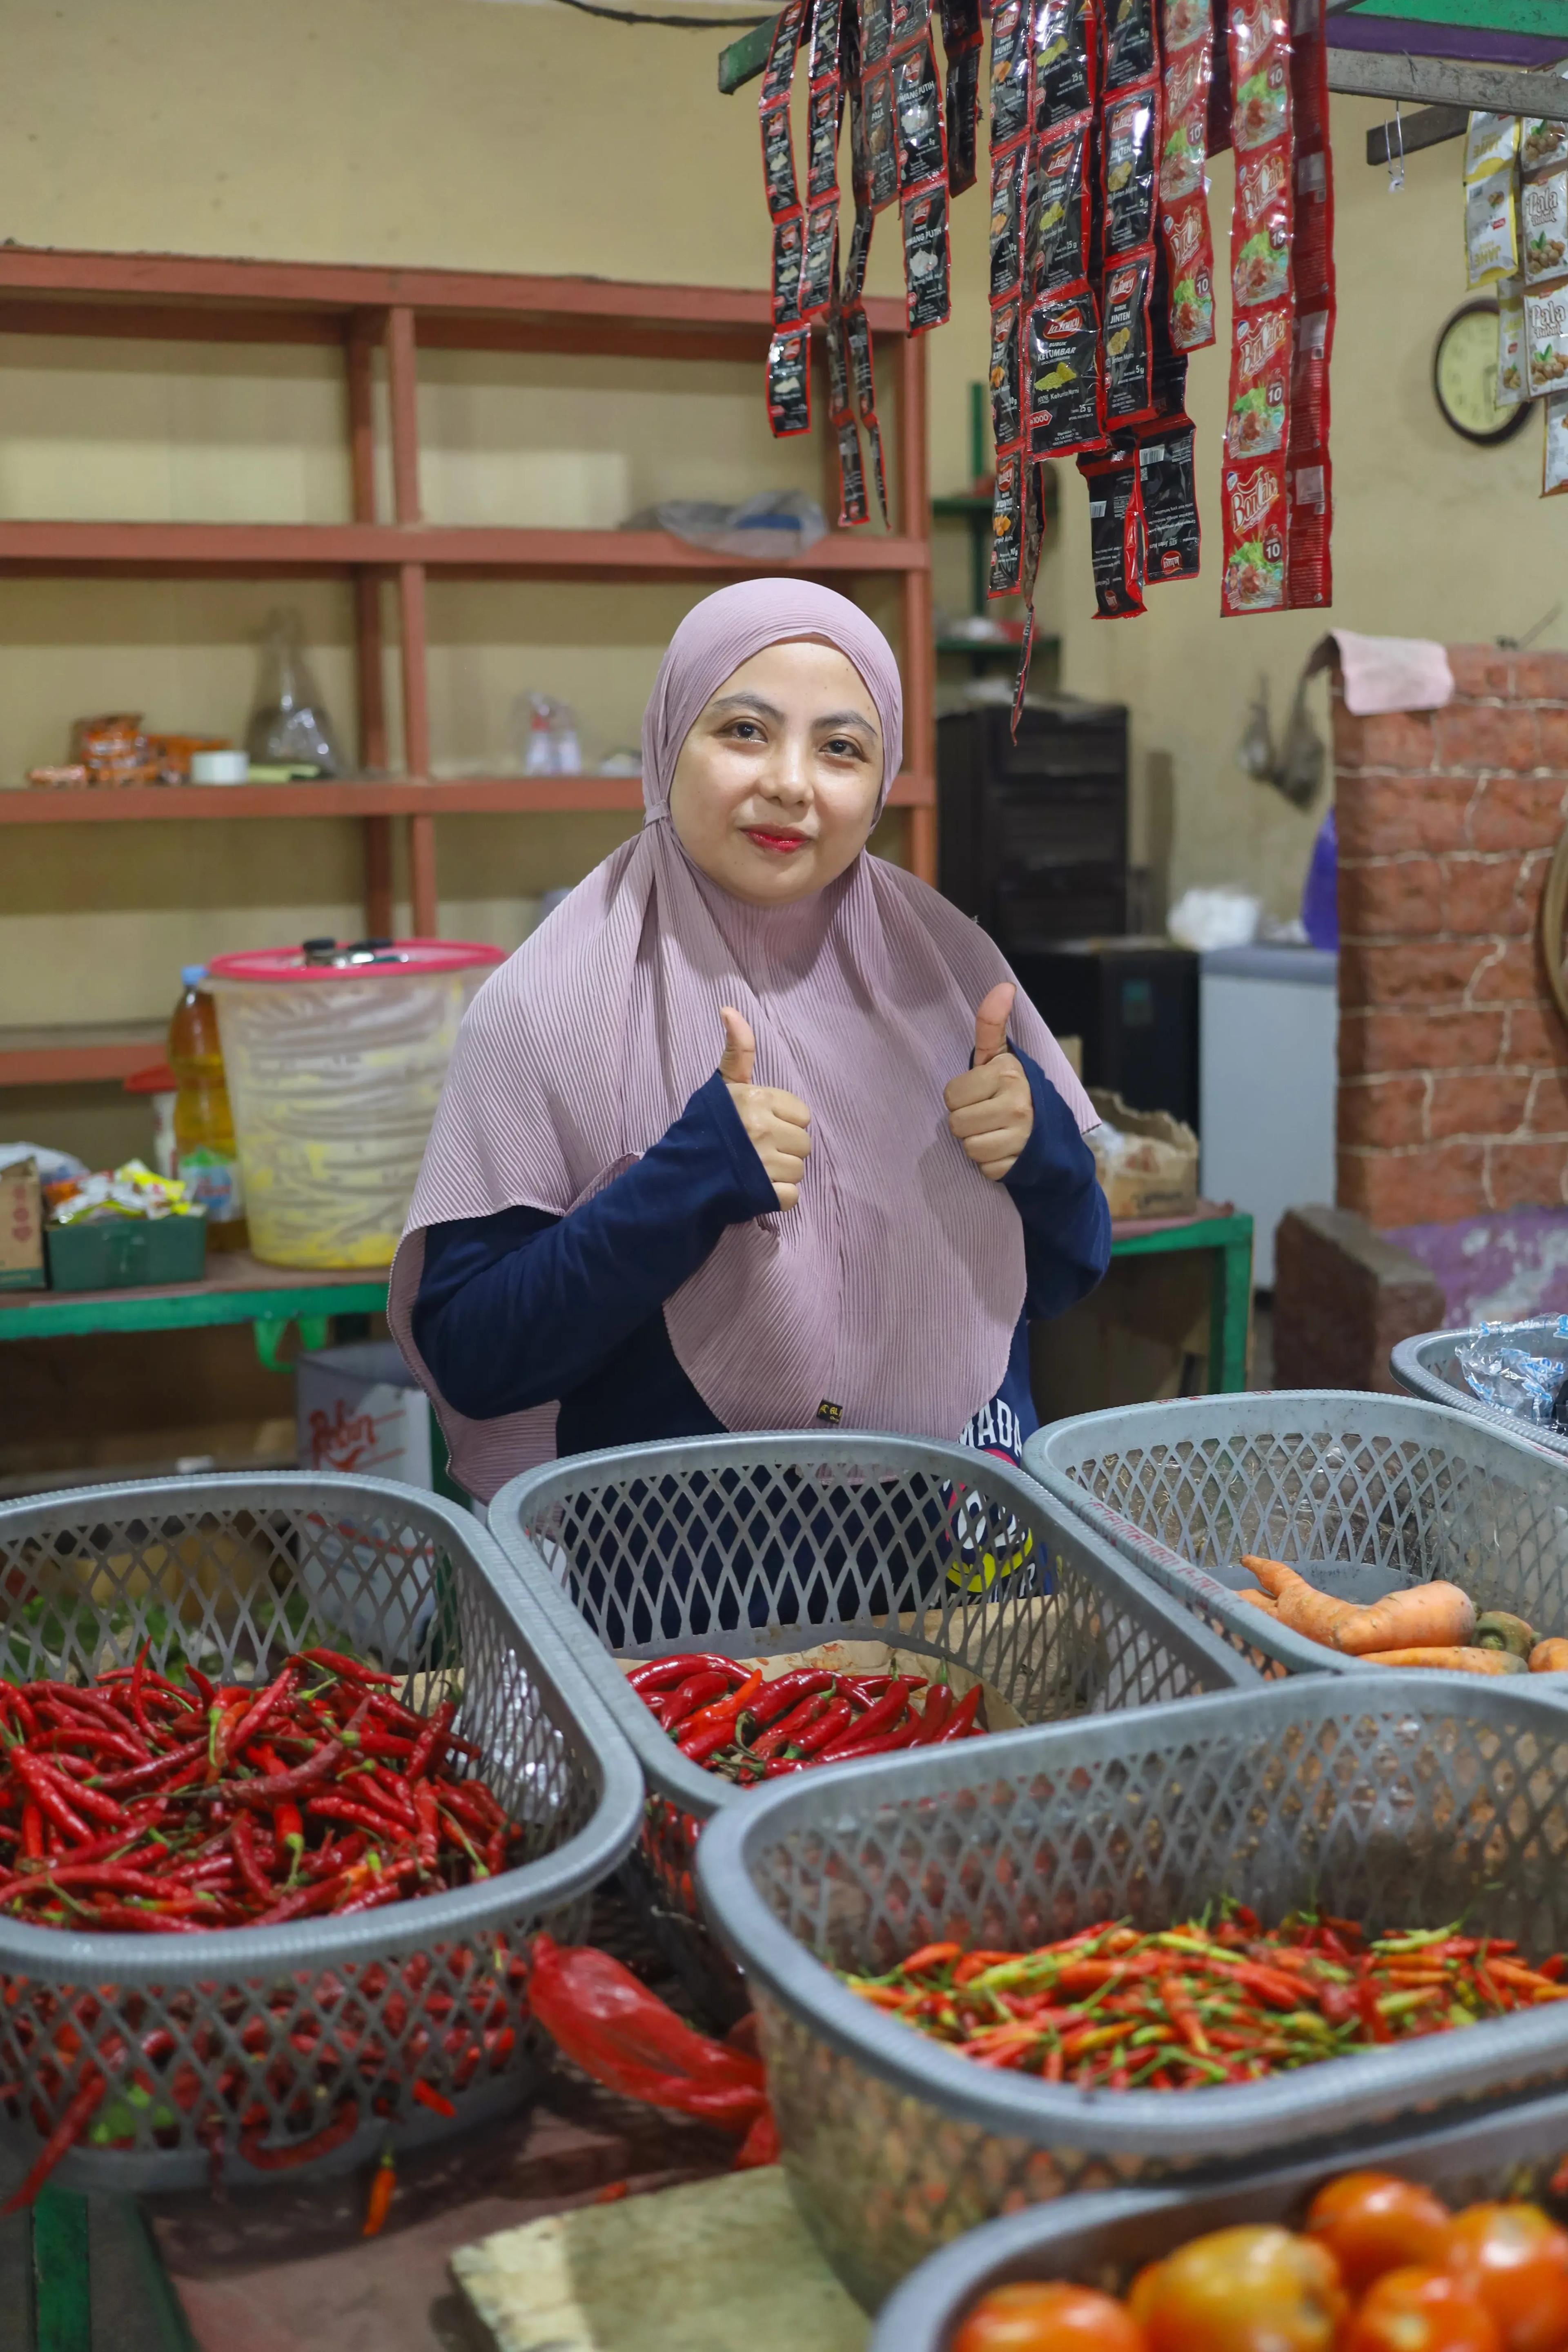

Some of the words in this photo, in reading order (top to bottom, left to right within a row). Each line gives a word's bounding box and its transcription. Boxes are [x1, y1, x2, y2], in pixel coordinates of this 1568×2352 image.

[994, 40, 1015, 56] KUNYIT
[1271, 67, 1283, 86] 10
[918, 81, 934, 95] PUTIH
[871, 108, 884, 122] PALA
[1190, 126, 1201, 142] 10
[1111, 144, 1131, 159] JINTEN
[1526, 187, 1558, 216] Pala
[1272, 230, 1284, 246] 10
[1197, 278, 1209, 294] 10
[1110, 311, 1131, 324] JINTEN
[1529, 301, 1566, 327] Pala
[1038, 347, 1076, 362] KETUMBAR
[1268, 387, 1282, 403] 10
[1232, 472, 1278, 533] BonCabe
[1266, 543, 1281, 559] 10
